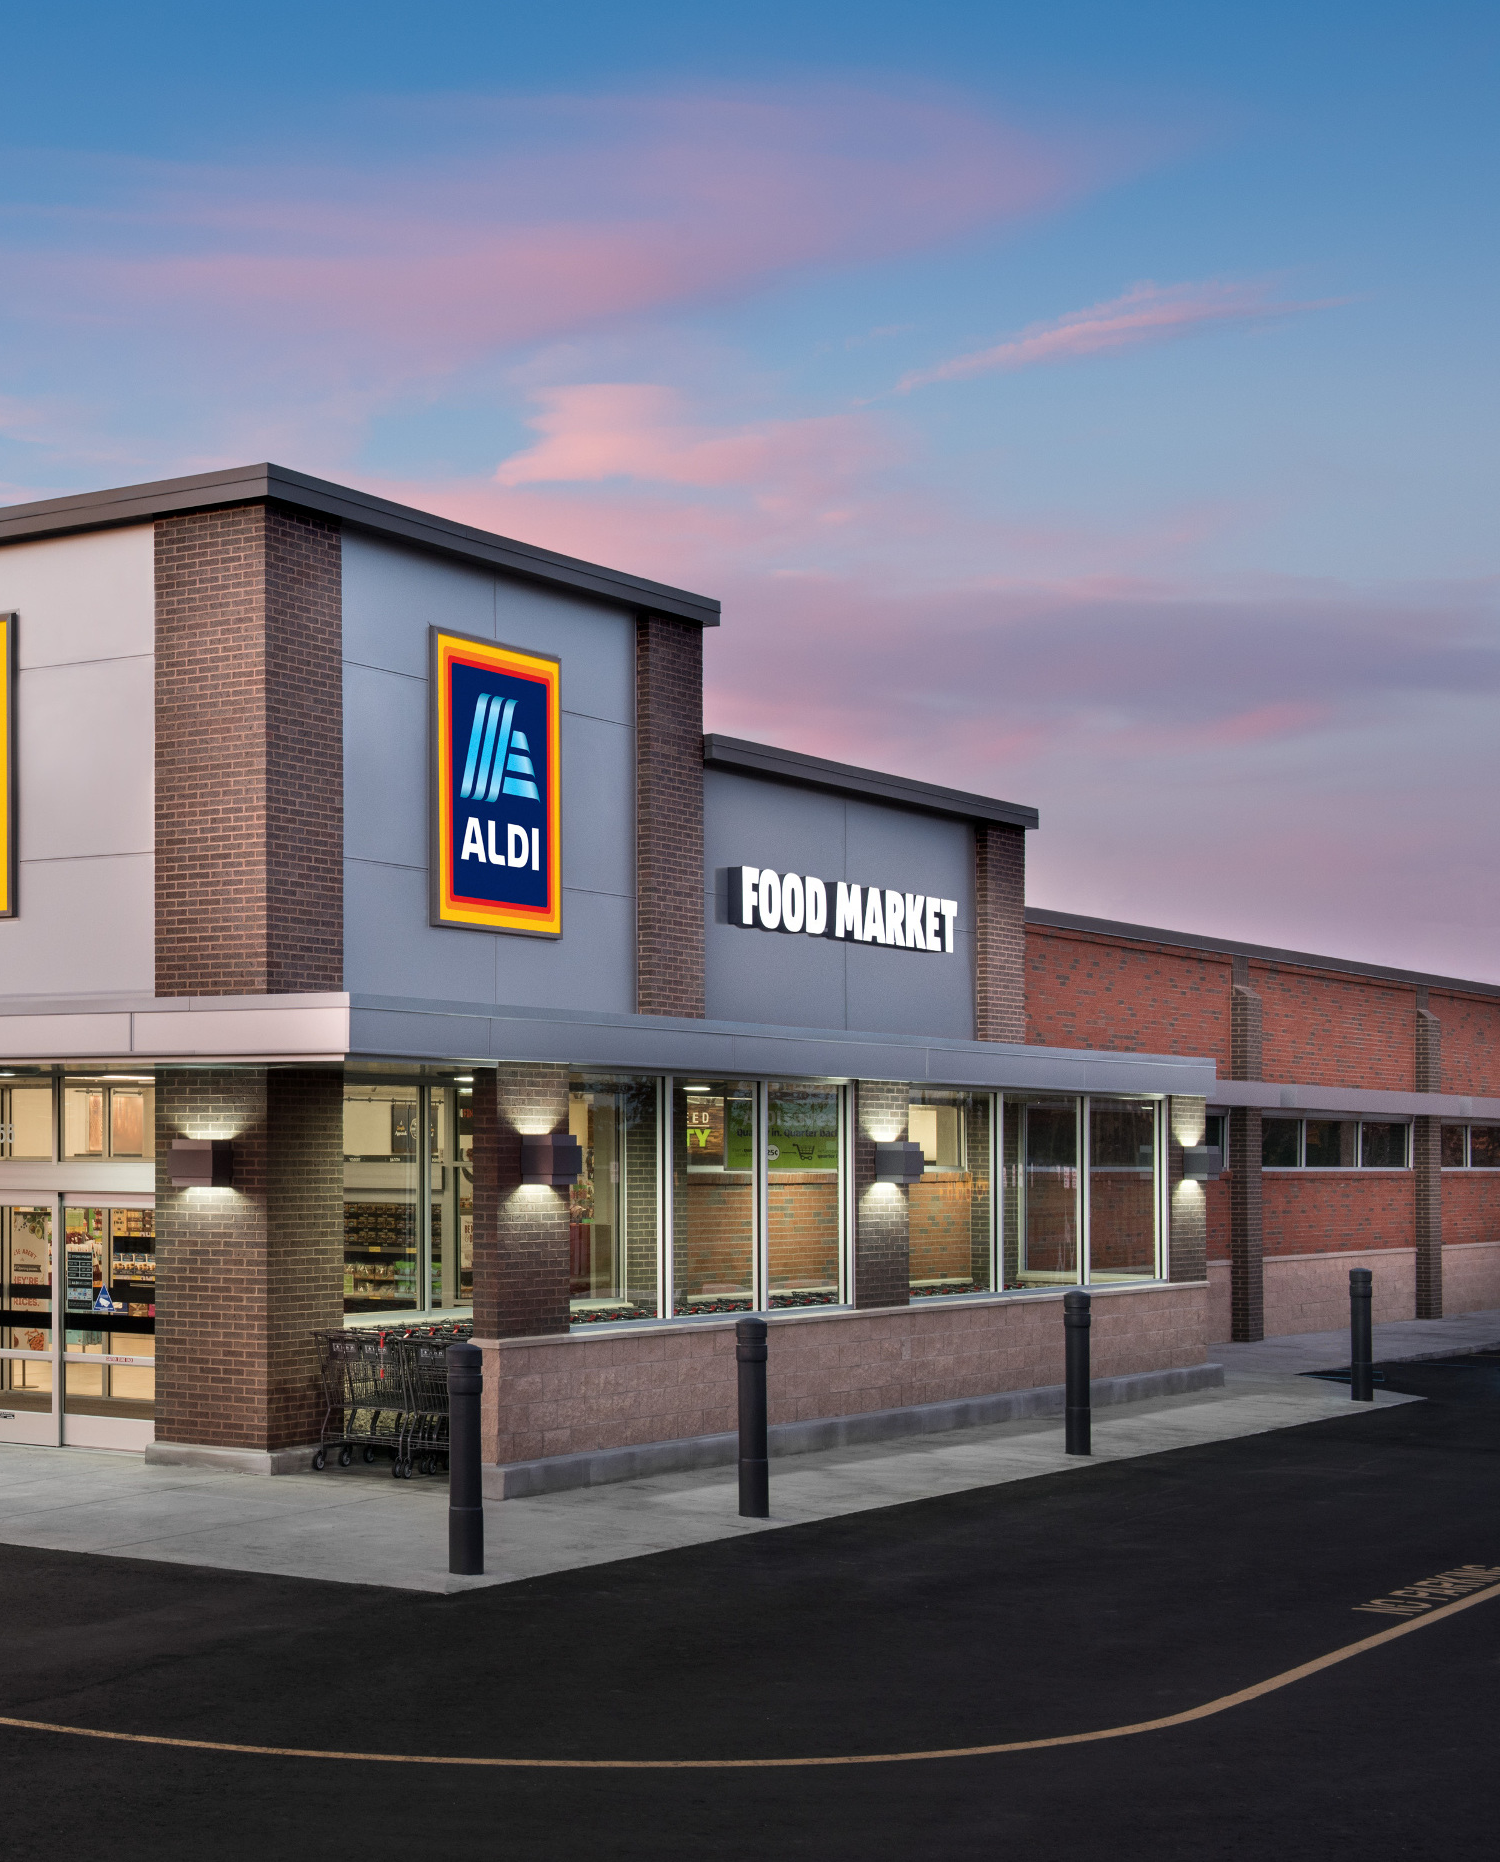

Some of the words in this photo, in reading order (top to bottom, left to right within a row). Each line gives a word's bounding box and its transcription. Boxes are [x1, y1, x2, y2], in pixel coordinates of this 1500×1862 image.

[461, 816, 540, 871] ALDI
[741, 865, 828, 935] FOOD
[834, 881, 958, 954] MARKET
[783, 1129, 817, 1138] Quarter
[22, 1248, 37, 1259] AREN'T
